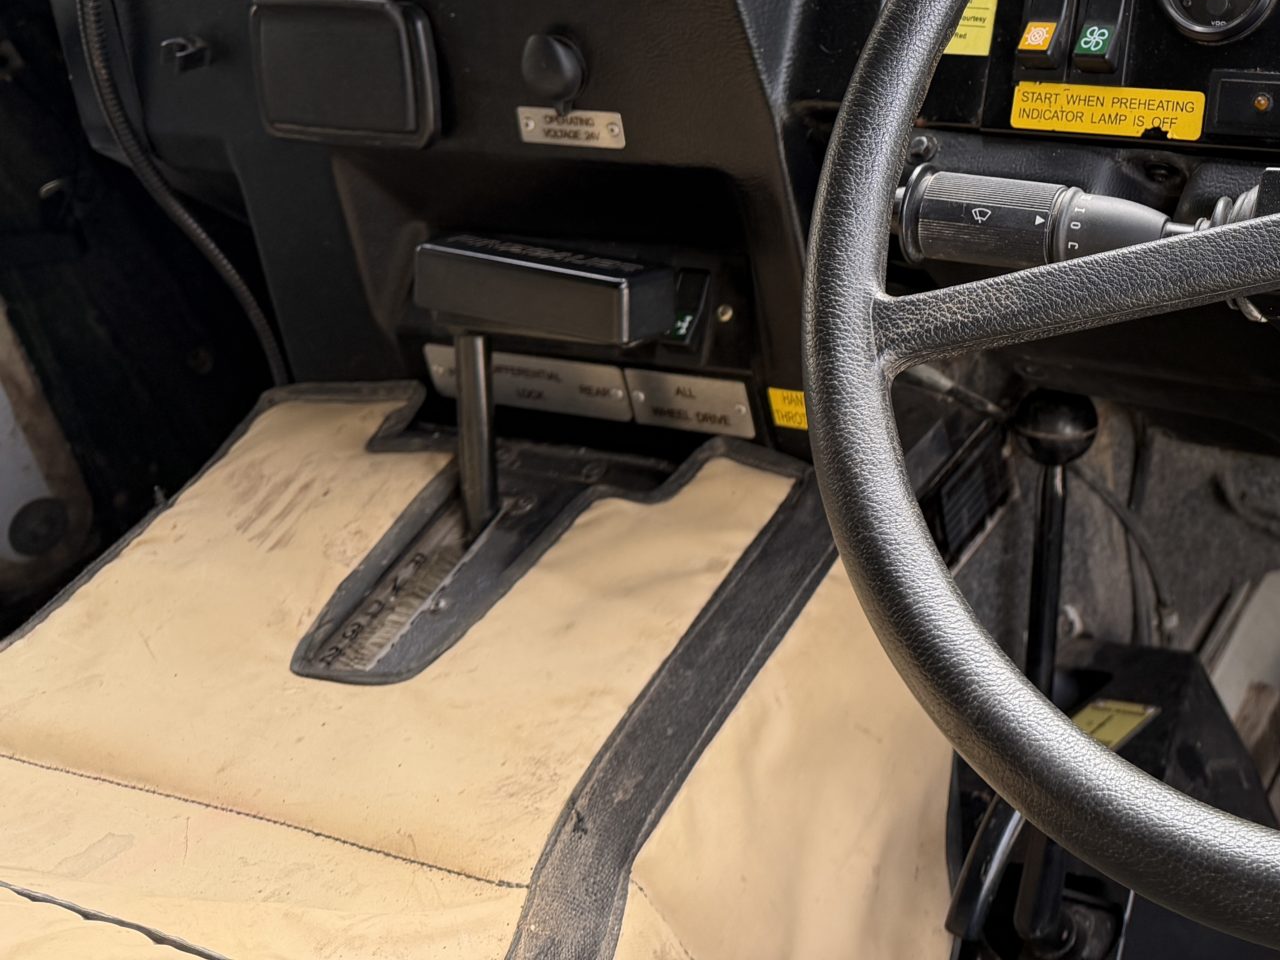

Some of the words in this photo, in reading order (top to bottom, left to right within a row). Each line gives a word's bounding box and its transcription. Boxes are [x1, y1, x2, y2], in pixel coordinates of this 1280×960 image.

[962, 15, 987, 24] ourtesy
[1021, 91, 1060, 104] START
[1066, 94, 1105, 108] WHEN
[1111, 98, 1195, 113] PREHEATING
[1018, 108, 1083, 123] INDICATOR
[1090, 112, 1127, 126] LAMP
[1133, 115, 1145, 126] IS
[1151, 117, 1178, 129] OFF
[543, 128, 579, 140] VOLTAGE
[493, 364, 561, 382] IFFERENTIAL
[516, 388, 544, 401] LOCK
[674, 386, 695, 398] ALL
[782, 392, 804, 407] HAN
[652, 406, 690, 420] WHEEL
[695, 411, 732, 426] DRIVE
